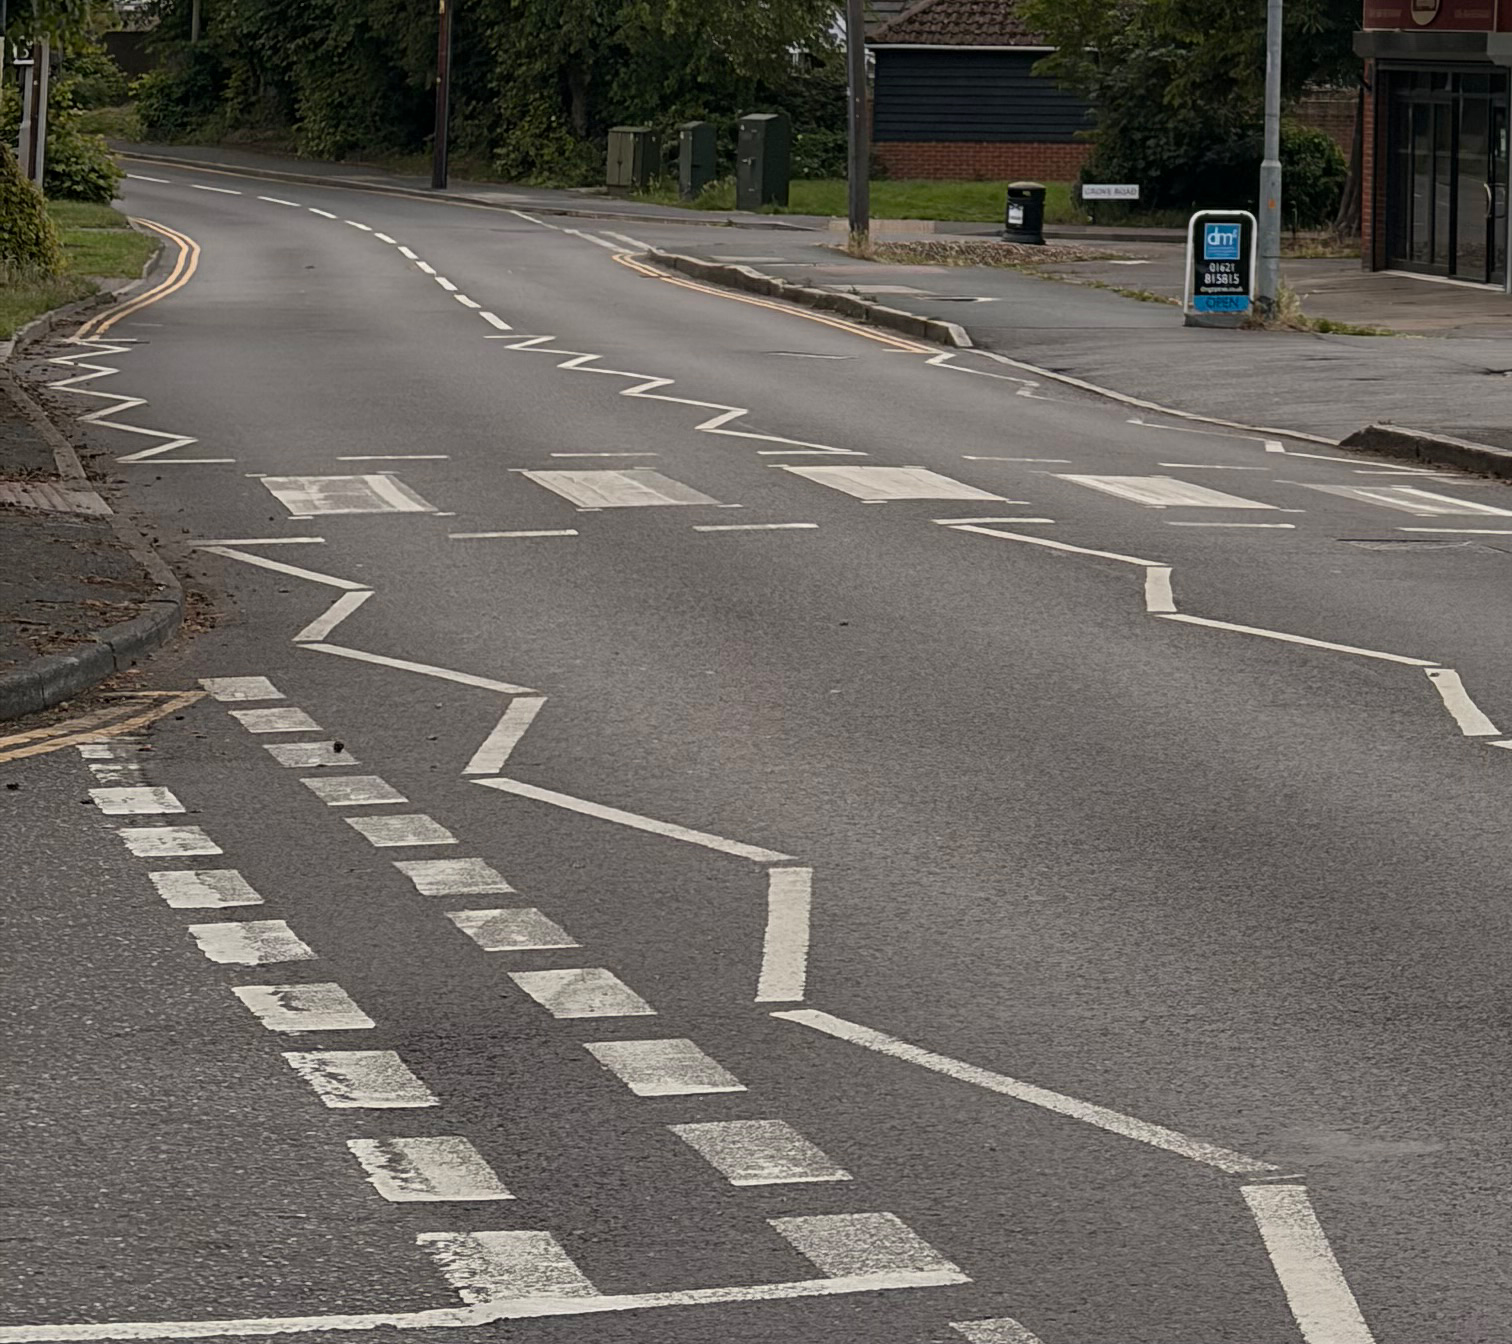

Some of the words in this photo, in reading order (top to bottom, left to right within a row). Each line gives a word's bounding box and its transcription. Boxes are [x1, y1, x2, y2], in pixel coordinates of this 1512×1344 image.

[1113, 187, 1137, 196] ROAD
[1209, 262, 1235, 273] 01621
[1204, 273, 1240, 284] 815815
[1206, 297, 1240, 309] OPEN
